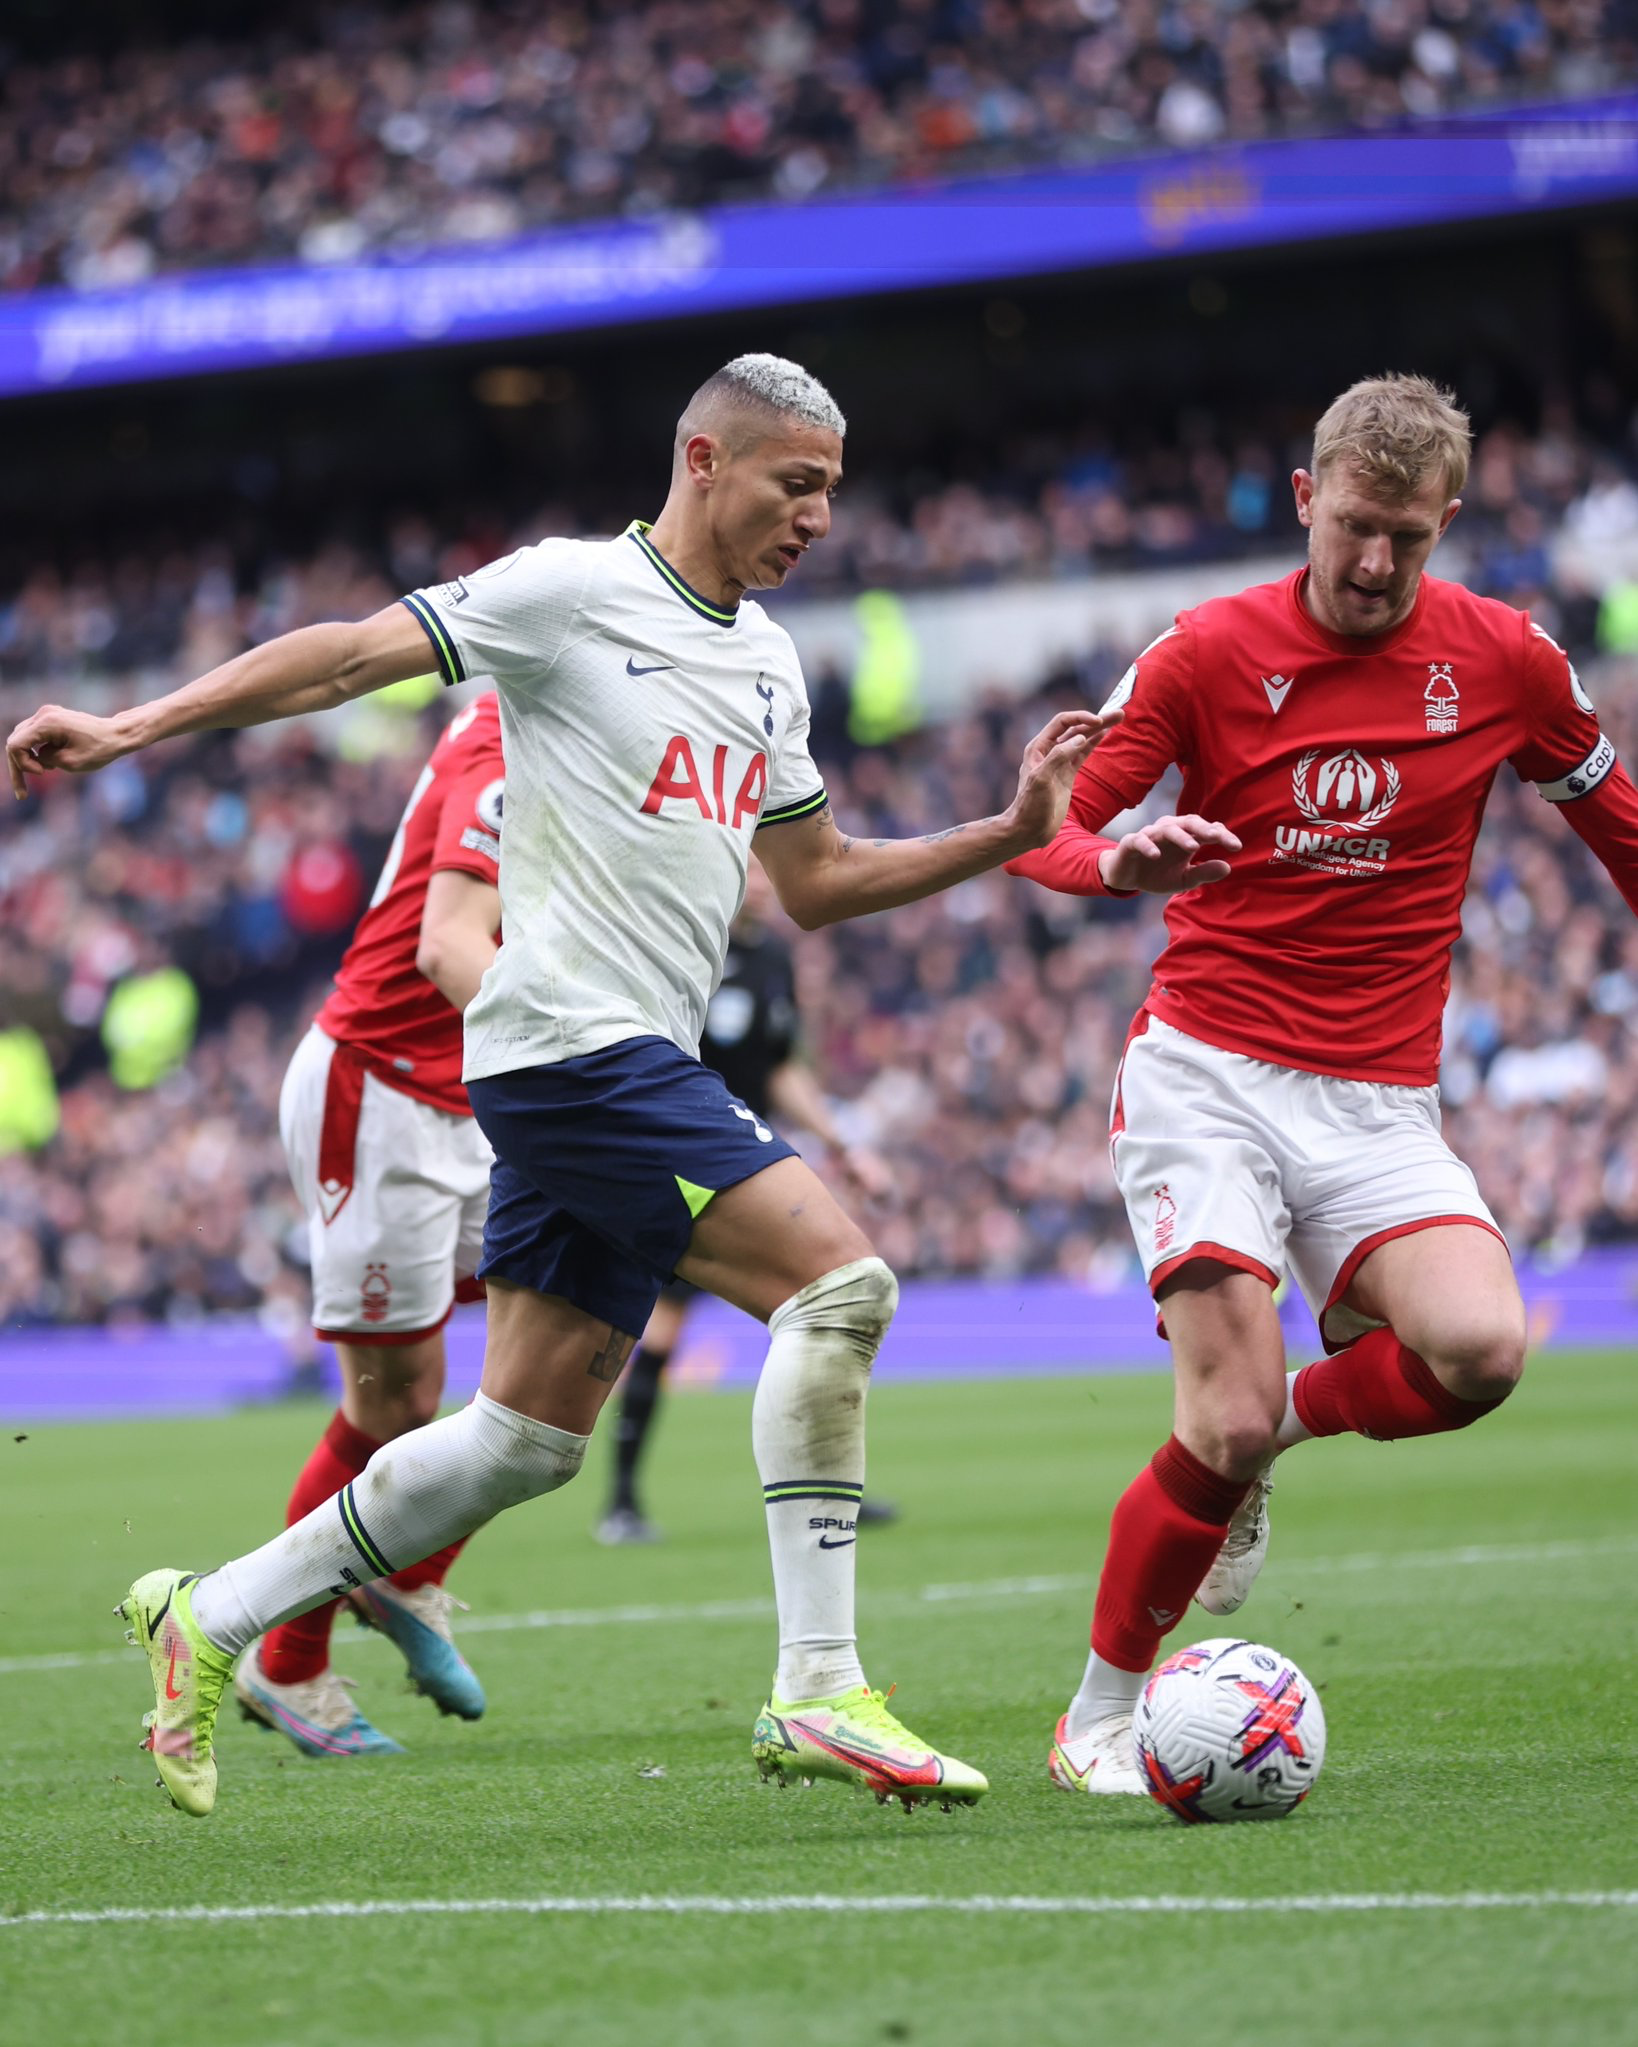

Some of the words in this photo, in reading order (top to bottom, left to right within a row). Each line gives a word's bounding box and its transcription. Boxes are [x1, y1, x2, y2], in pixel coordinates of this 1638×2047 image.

[1275, 825, 1390, 861] UNHCR
[1335, 866, 1349, 876] for
[1348, 857, 1386, 872] Agency
